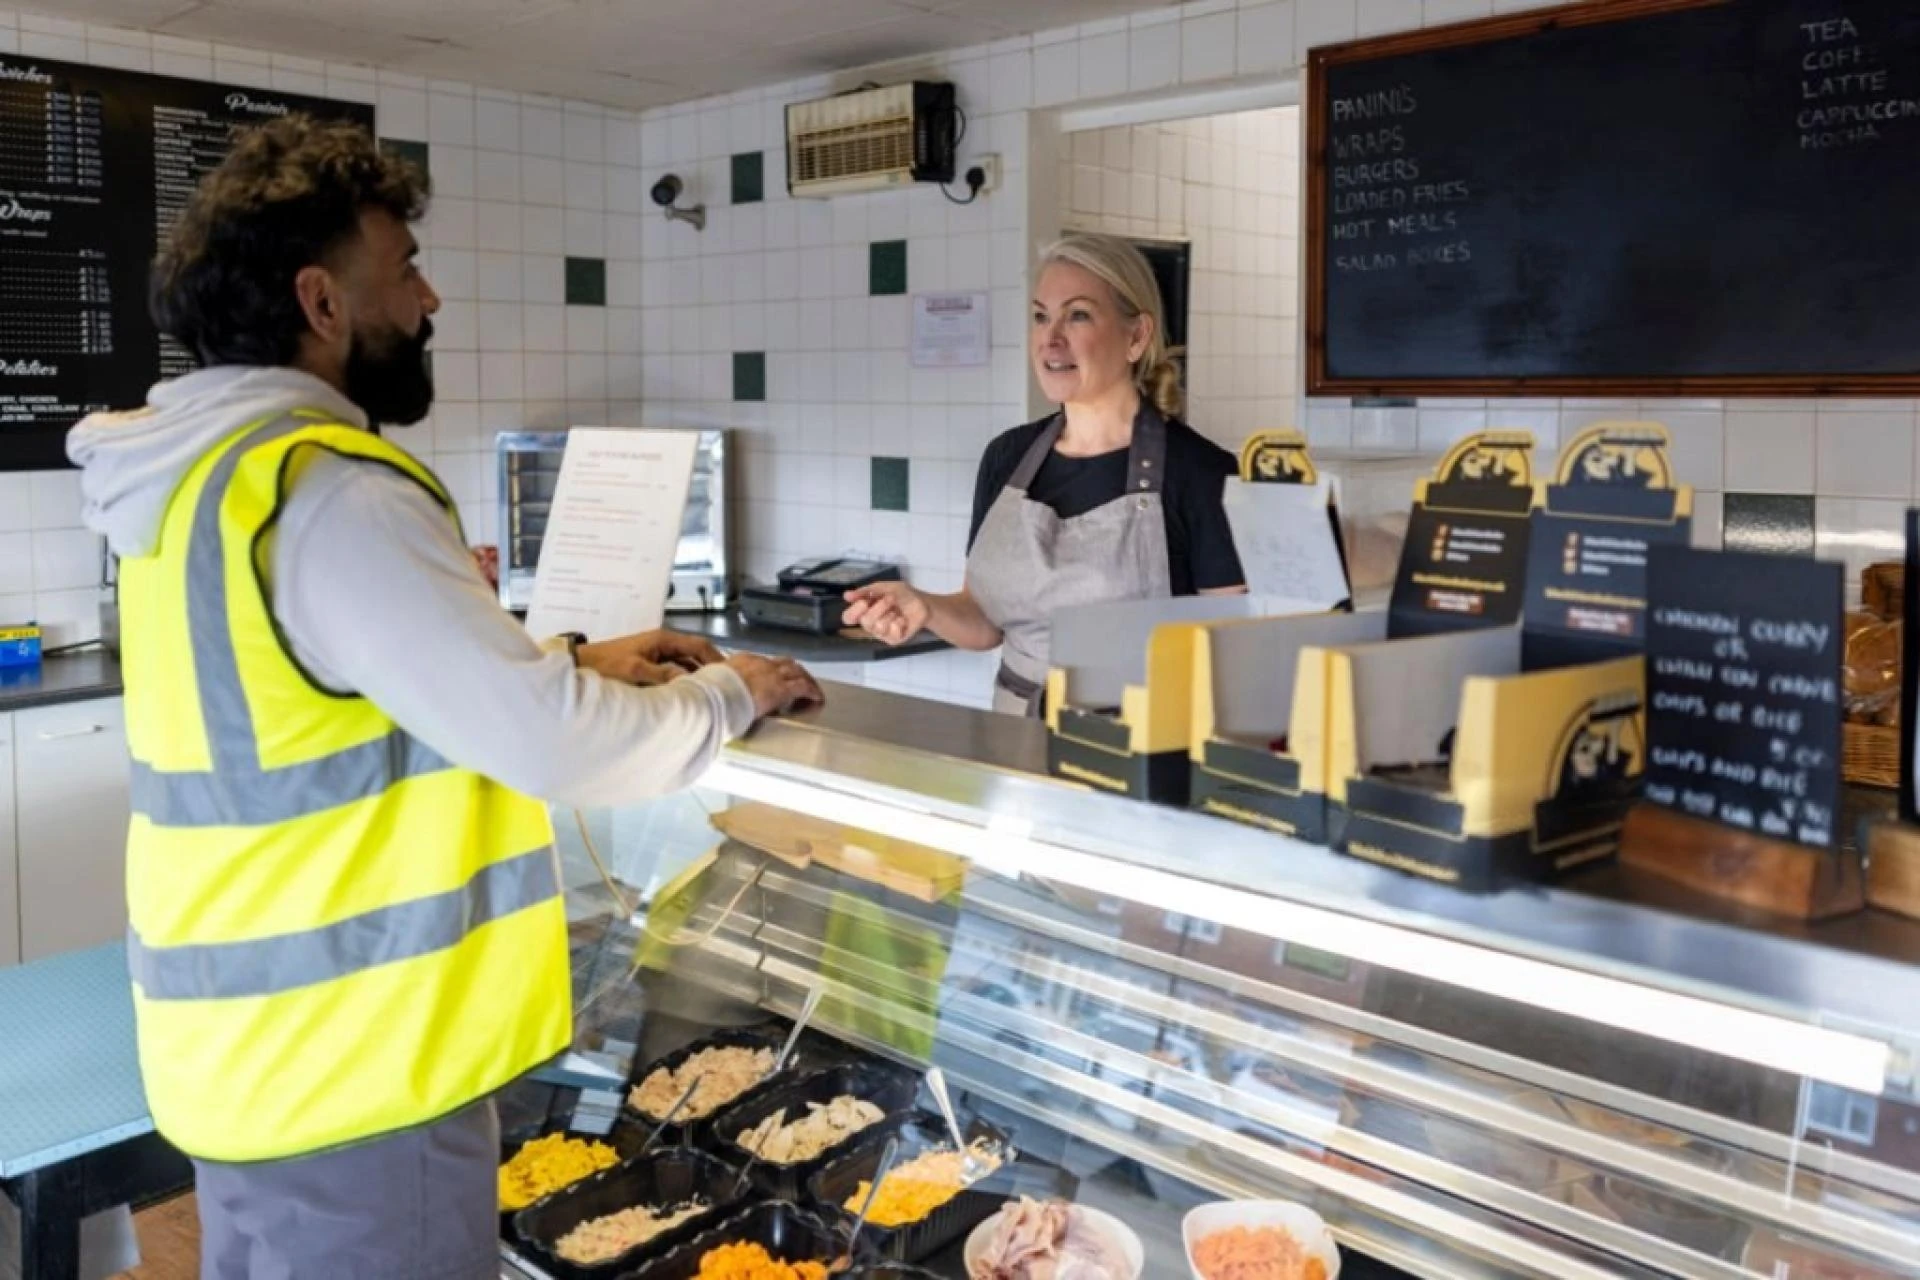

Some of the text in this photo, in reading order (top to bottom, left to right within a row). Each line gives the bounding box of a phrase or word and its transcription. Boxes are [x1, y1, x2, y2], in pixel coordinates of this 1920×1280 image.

[1800, 17, 1858, 42] TEA
[1802, 70, 1887, 99] LATTE
[1333, 83, 1417, 121] PANINIS
[1334, 125, 1405, 159] WRAPS
[1334, 158, 1419, 187] BURGERS
[1335, 180, 1469, 214] LOADED FRIES
[1333, 210, 1456, 240] HOT MEALS
[1336, 253, 1396, 271] SALAD
